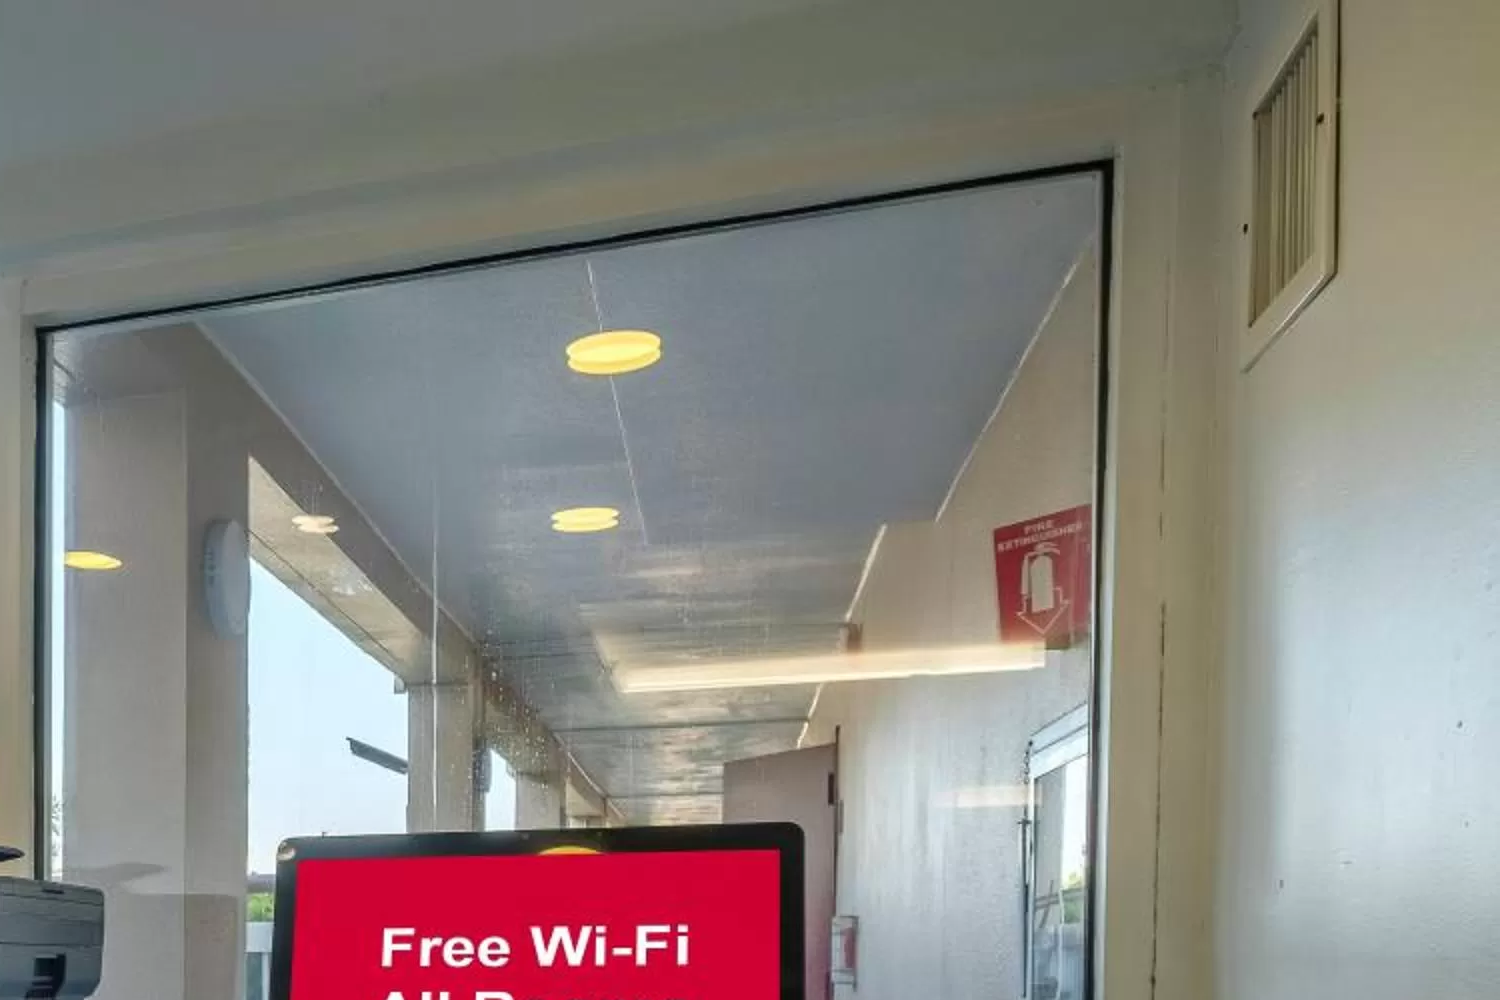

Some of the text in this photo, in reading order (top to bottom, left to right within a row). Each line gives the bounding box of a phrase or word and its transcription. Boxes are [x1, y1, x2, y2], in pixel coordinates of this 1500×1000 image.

[1024, 520, 1054, 535] FIRE
[382, 925, 688, 967] Free Wi-Fi
